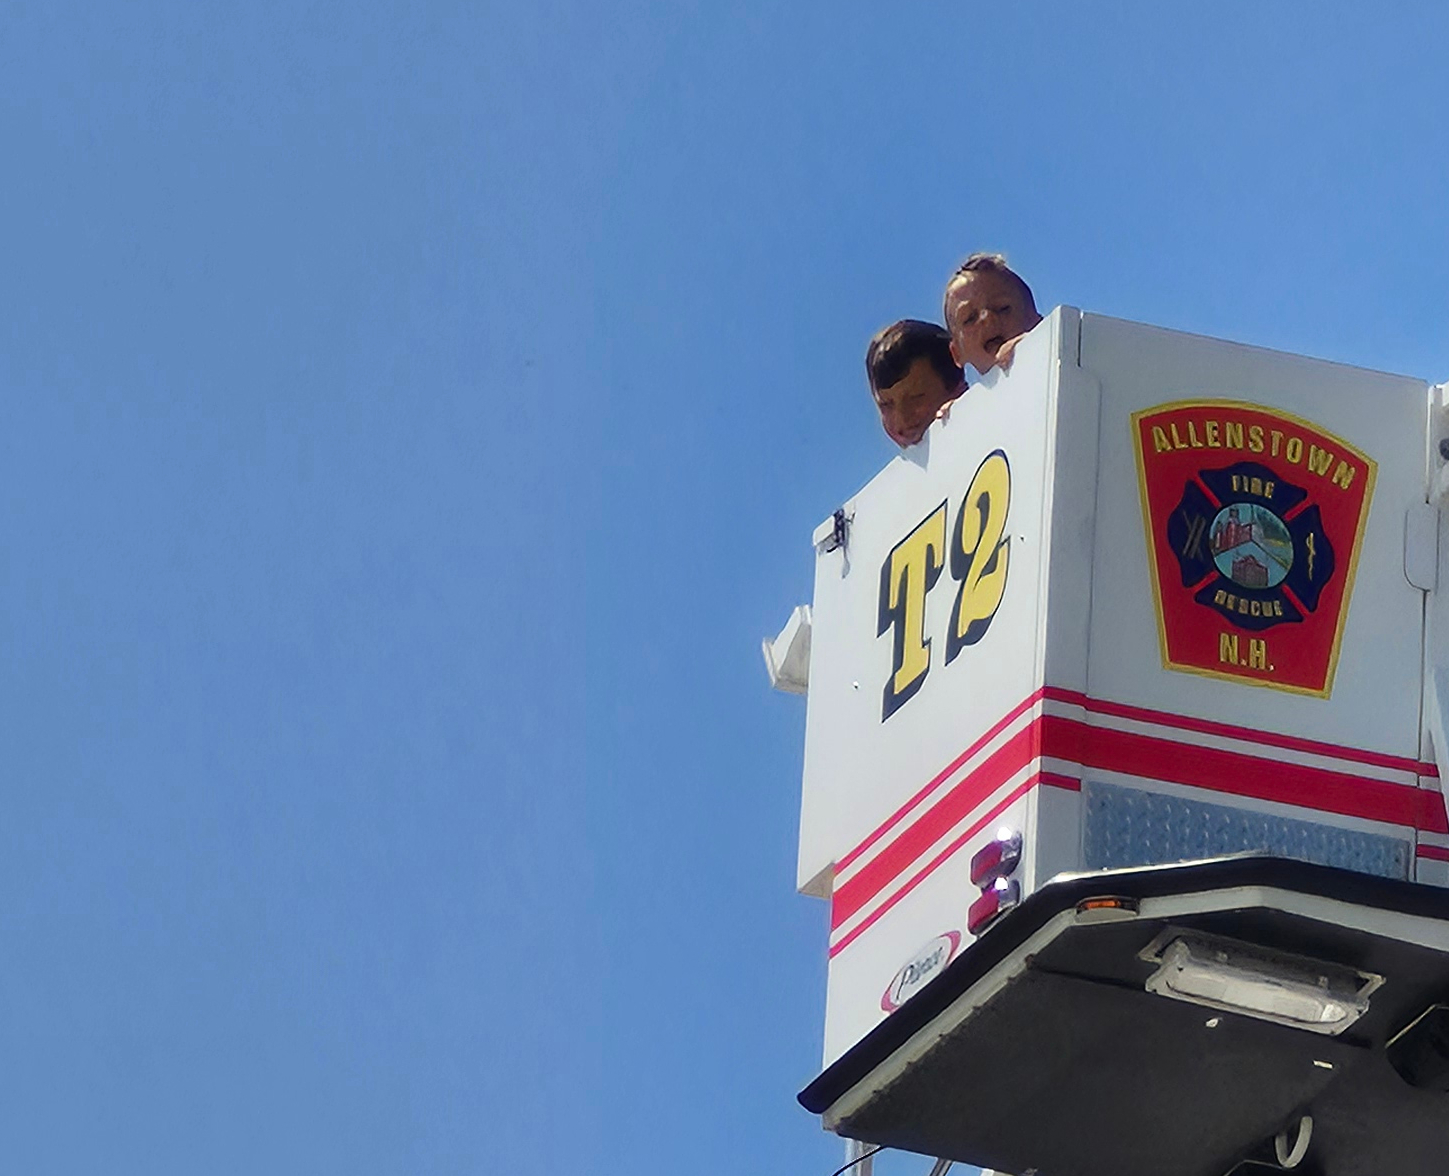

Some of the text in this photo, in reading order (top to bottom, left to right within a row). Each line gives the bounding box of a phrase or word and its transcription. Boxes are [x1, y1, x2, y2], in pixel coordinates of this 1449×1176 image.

[1153, 420, 1356, 490] ALLENSTOWN
[1231, 475, 1275, 499] FIRE
[877, 449, 1012, 723] T2
[1214, 589, 1283, 617] RESCUE
[1219, 632, 1275, 671] N.H.
